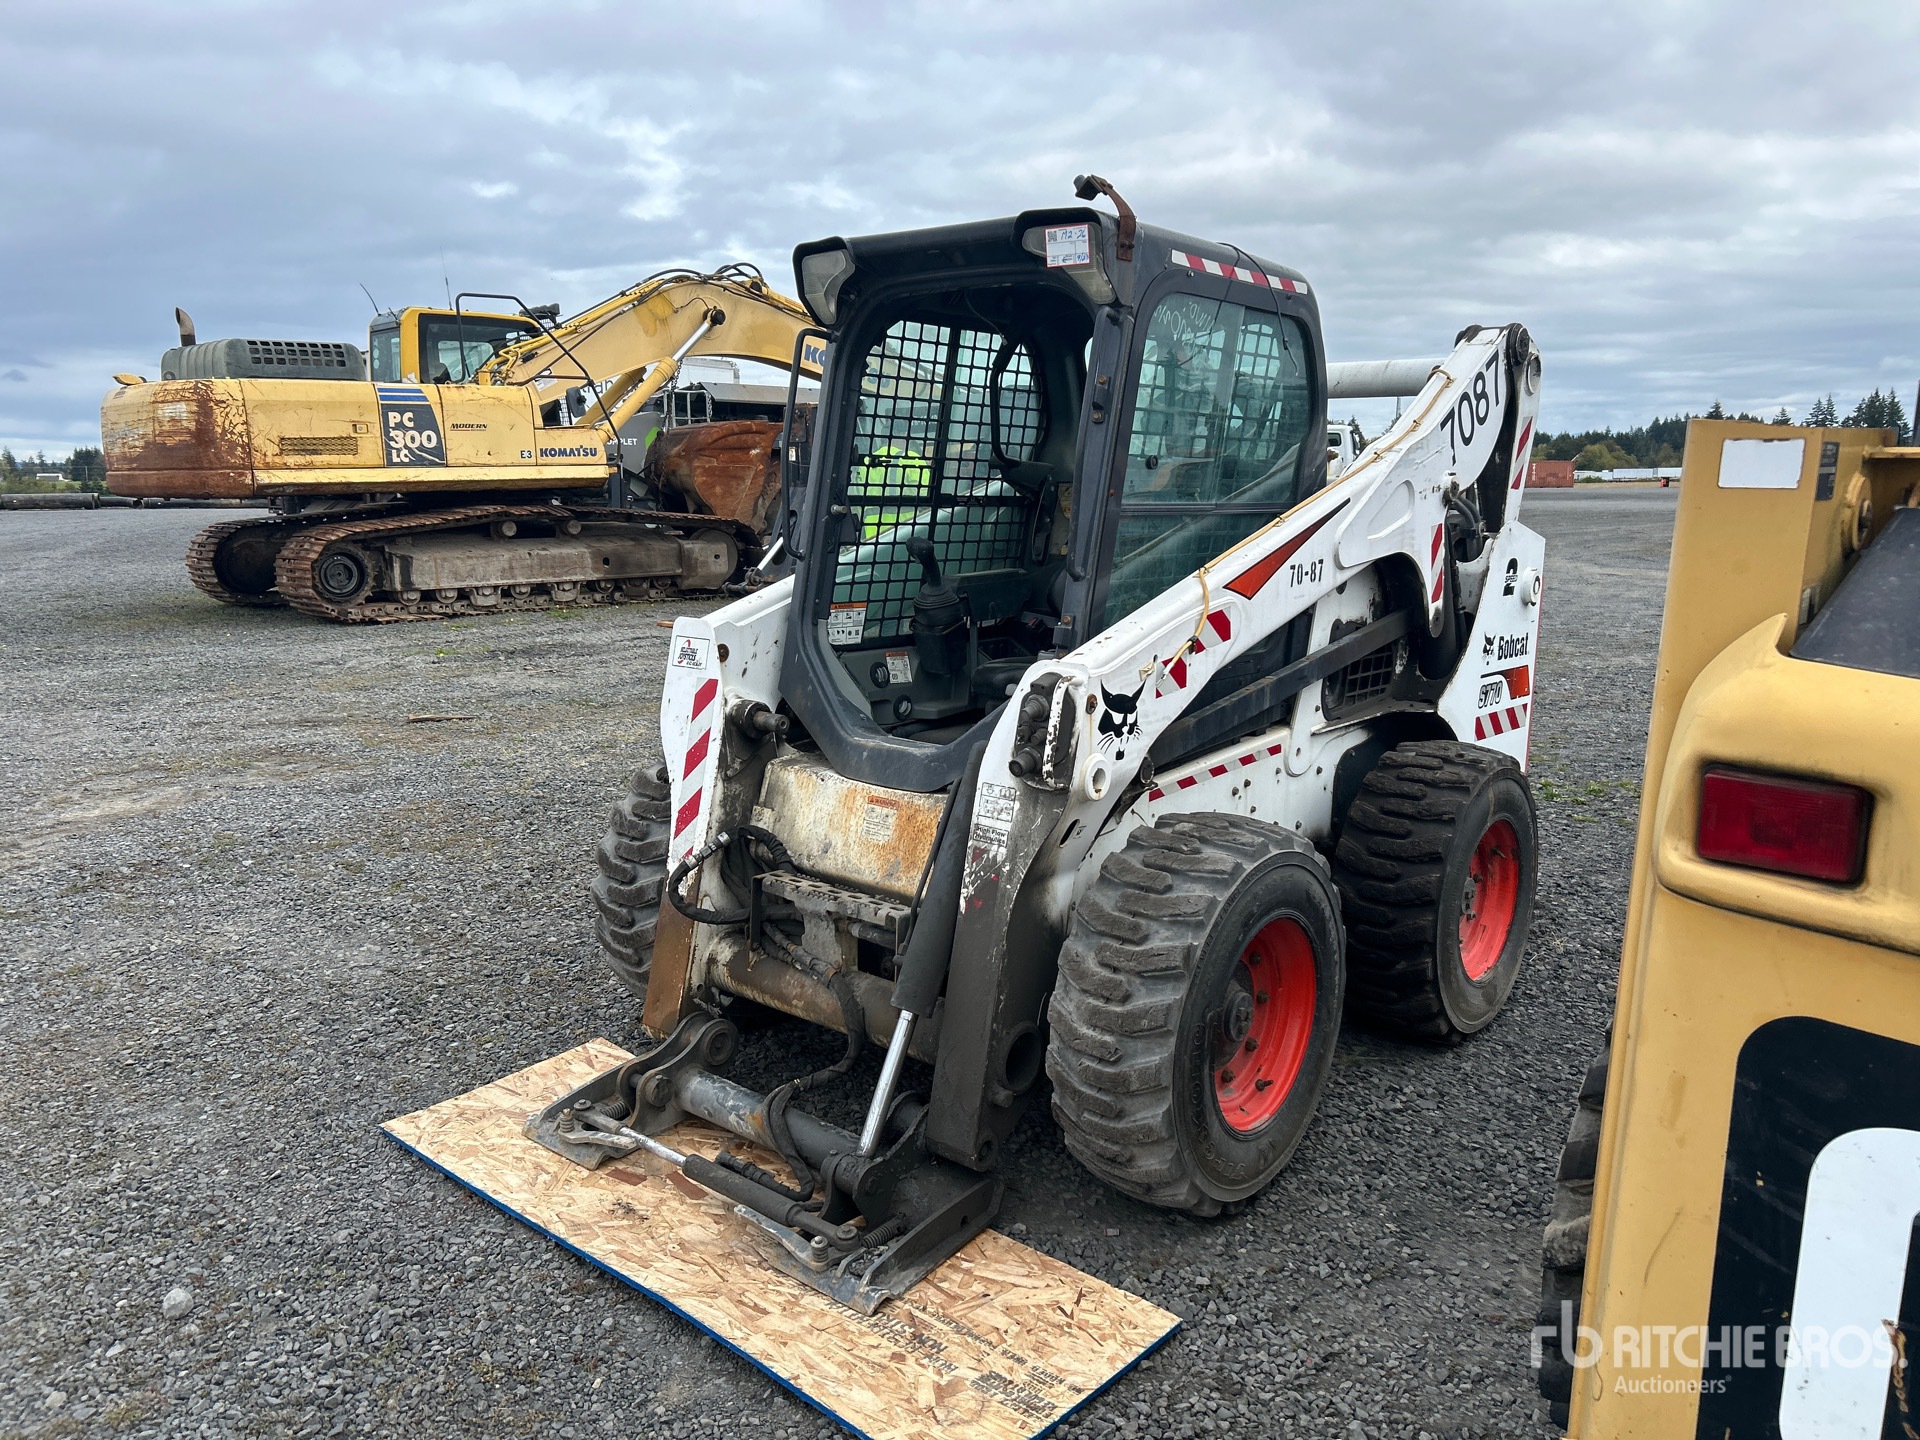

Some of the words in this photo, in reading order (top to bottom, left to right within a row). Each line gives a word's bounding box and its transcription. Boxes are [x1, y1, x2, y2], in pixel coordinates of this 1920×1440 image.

[1440, 349, 1500, 466] 7087
[387, 412, 414, 427] PC
[389, 430, 437, 448] 300
[391, 450, 410, 463] LC
[540, 445, 597, 457] KOMATSU
[1290, 559, 1324, 587] 70-87
[1497, 632, 1529, 660] Bobcat
[1478, 680, 1503, 709] S770
[991, 829, 1006, 838] Flow
